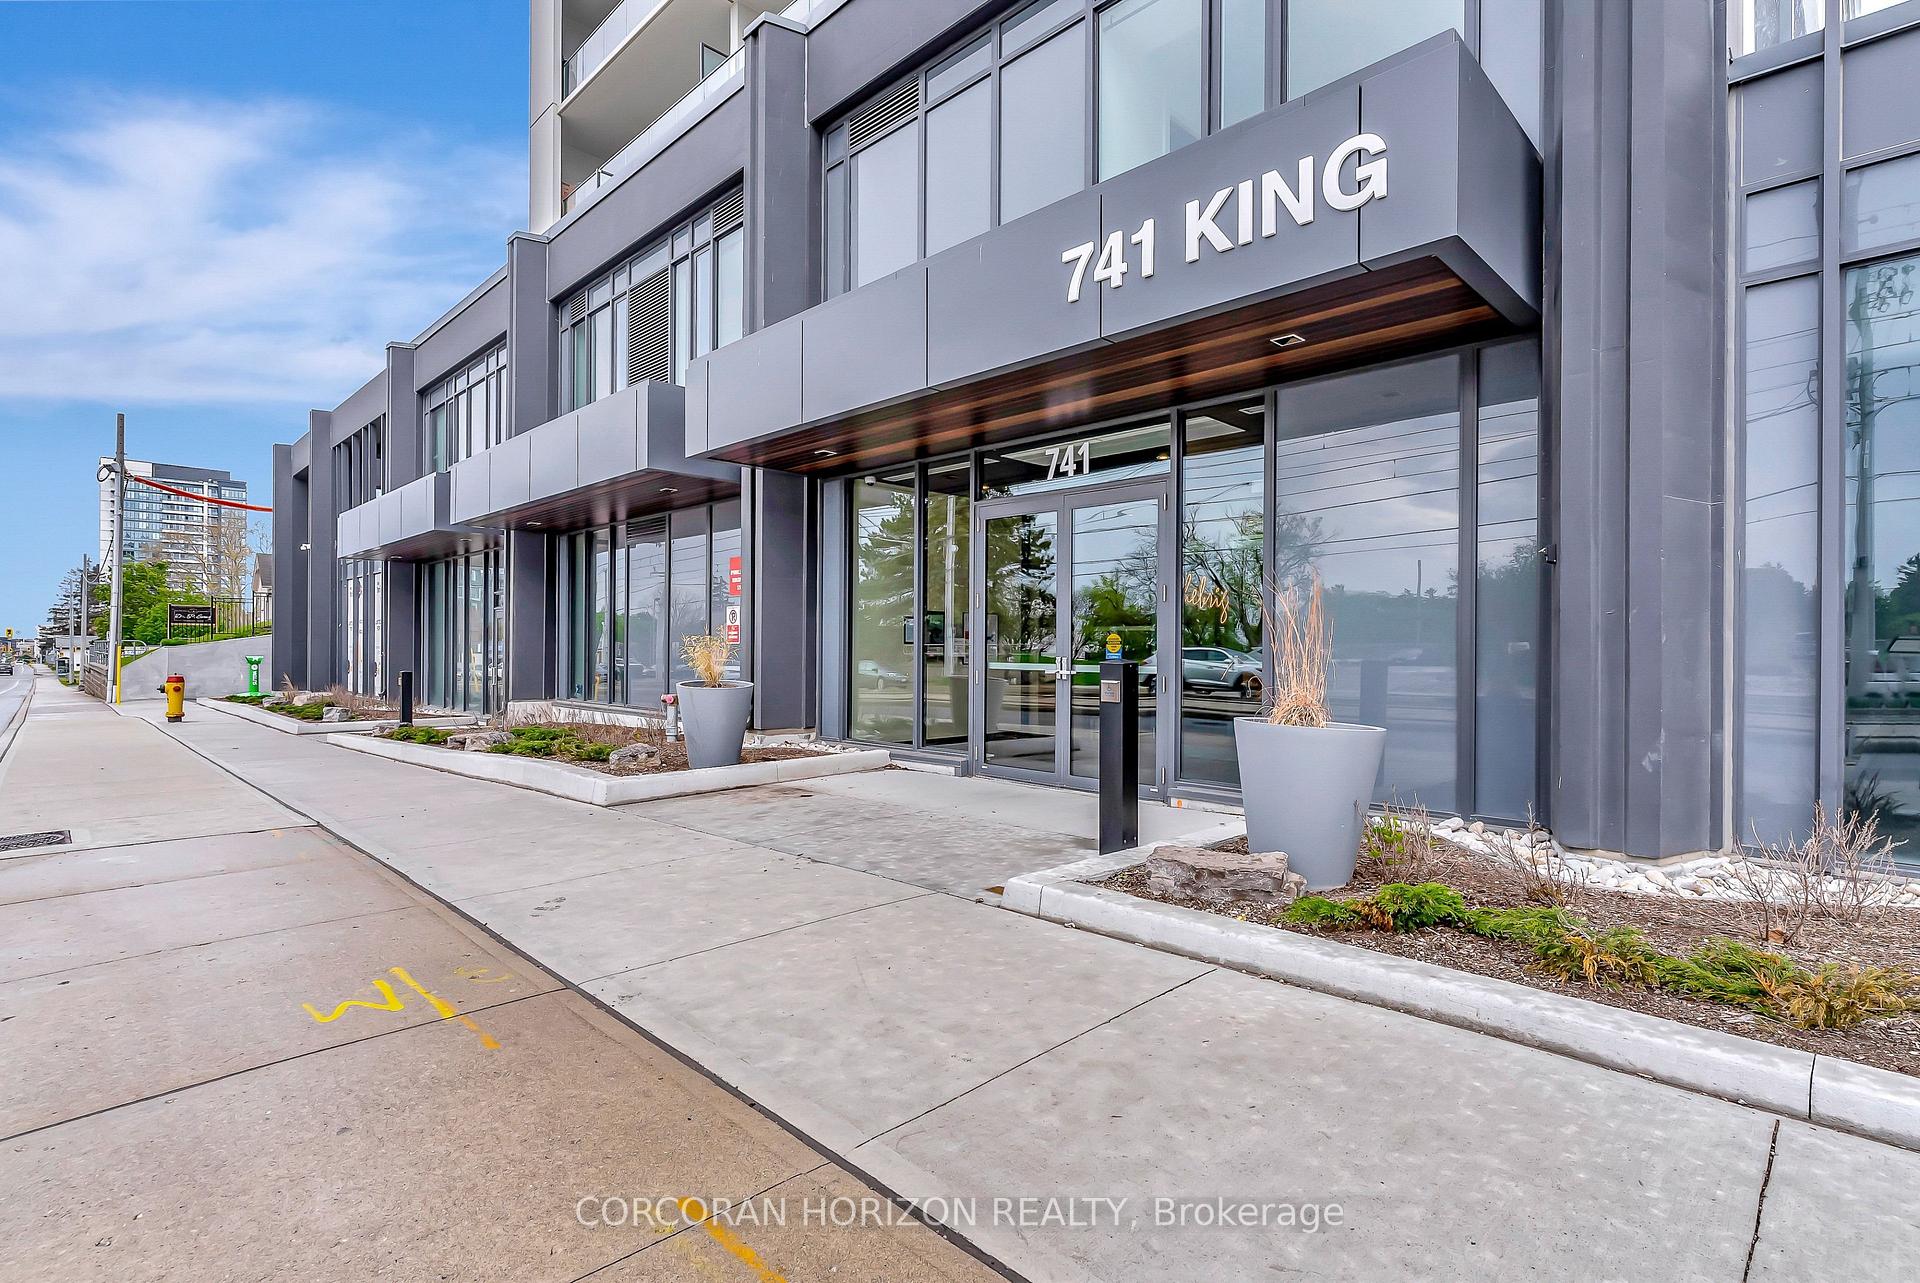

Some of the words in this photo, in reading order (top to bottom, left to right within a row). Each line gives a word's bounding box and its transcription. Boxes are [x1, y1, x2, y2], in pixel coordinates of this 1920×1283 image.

[1061, 218, 1155, 303] 741
[1185, 133, 1387, 263] KING
[1045, 441, 1090, 480] 741
